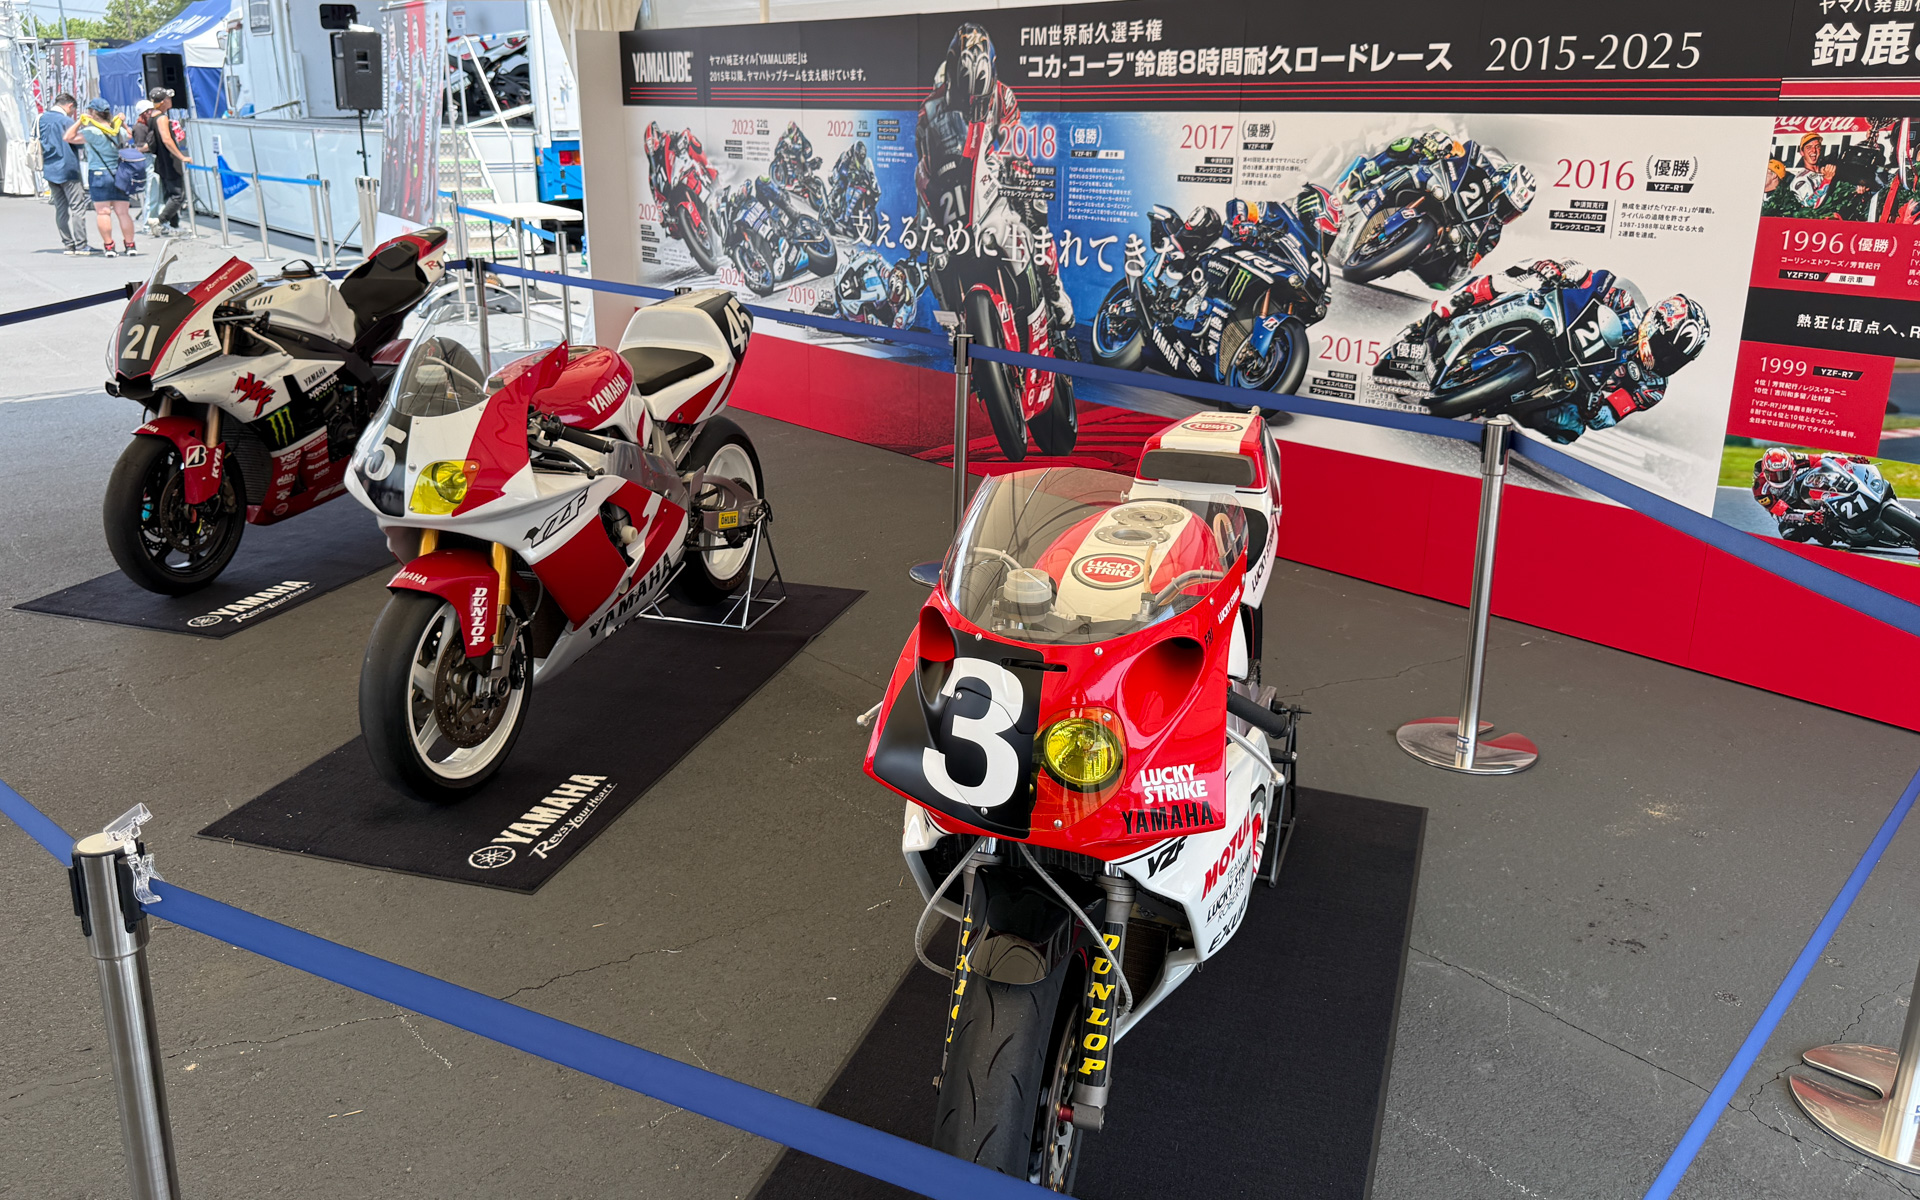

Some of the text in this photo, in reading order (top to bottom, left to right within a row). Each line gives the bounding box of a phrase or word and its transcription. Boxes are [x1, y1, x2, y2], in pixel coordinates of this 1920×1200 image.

[1819, 0, 1920, 15] ヤマハ発動
[1020, 18, 1163, 47] FIM世界耐久選手権
[1811, 20, 1920, 67] 鈴鹿
[1485, 31, 1703, 73] 2015-2025
[632, 51, 693, 83] YAMALUBE
[732, 119, 755, 136] 2023
[827, 120, 854, 137] 2022
[999, 124, 1056, 158] 2018
[1074, 128, 1097, 145] 優勝
[1180, 124, 1234, 150] 2017
[1247, 123, 1271, 138] 優勝
[1553, 158, 1635, 191] 2016
[1654, 159, 1690, 178] 優勝
[1459, 182, 1484, 216] 21
[1654, 183, 1684, 192] YZF-R1
[940, 184, 966, 226] 21
[1554, 223, 1602, 232] アレックス・ローズ
[1781, 229, 1844, 255] 1996
[1858, 237, 1889, 254] 優勝
[228, 273, 257, 295] YAMAHA
[1787, 271, 1820, 280] YZF750
[1839, 275, 1863, 284] 展示車
[787, 285, 816, 307] 2019
[187, 329, 210, 341] R1
[723, 296, 753, 355] 45
[1574, 320, 1605, 358] 21
[121, 323, 160, 361] 21
[182, 338, 214, 357] YAMALUBE
[1152, 326, 1180, 371] YAMAHA
[1319, 334, 1381, 367] 2015
[1396, 342, 1424, 359] 優勝
[303, 366, 328, 387] YAMAHA
[1396, 362, 1419, 371] YZF-R1
[1760, 356, 1807, 377] 1999
[1821, 368, 1854, 379] YZF-R7
[587, 373, 629, 415] YAMAHA
[364, 423, 407, 481] 5
[523, 487, 589, 549] YZF
[1084, 566, 1135, 578] STRIKE
[1087, 559, 1139, 571] LUCKY
[207, 580, 310, 616] YAMAHA
[588, 552, 673, 639] YAMAHA
[469, 587, 488, 646] DUNLOP
[1217, 603, 1232, 625] LUCKY
[922, 656, 1024, 807] 3
[1139, 763, 1196, 787] LUCKY
[1144, 780, 1209, 805] STRIKE
[491, 774, 608, 844] YAMAHA
[528, 783, 615, 860] Revs Your Heart
[1121, 801, 1214, 835] YAMAHA
[1201, 809, 1251, 902] MOTUL
[1206, 883, 1234, 923] LUCKY
[1208, 894, 1247, 954] EXUP
[1078, 933, 1121, 1076] DUNLOP
